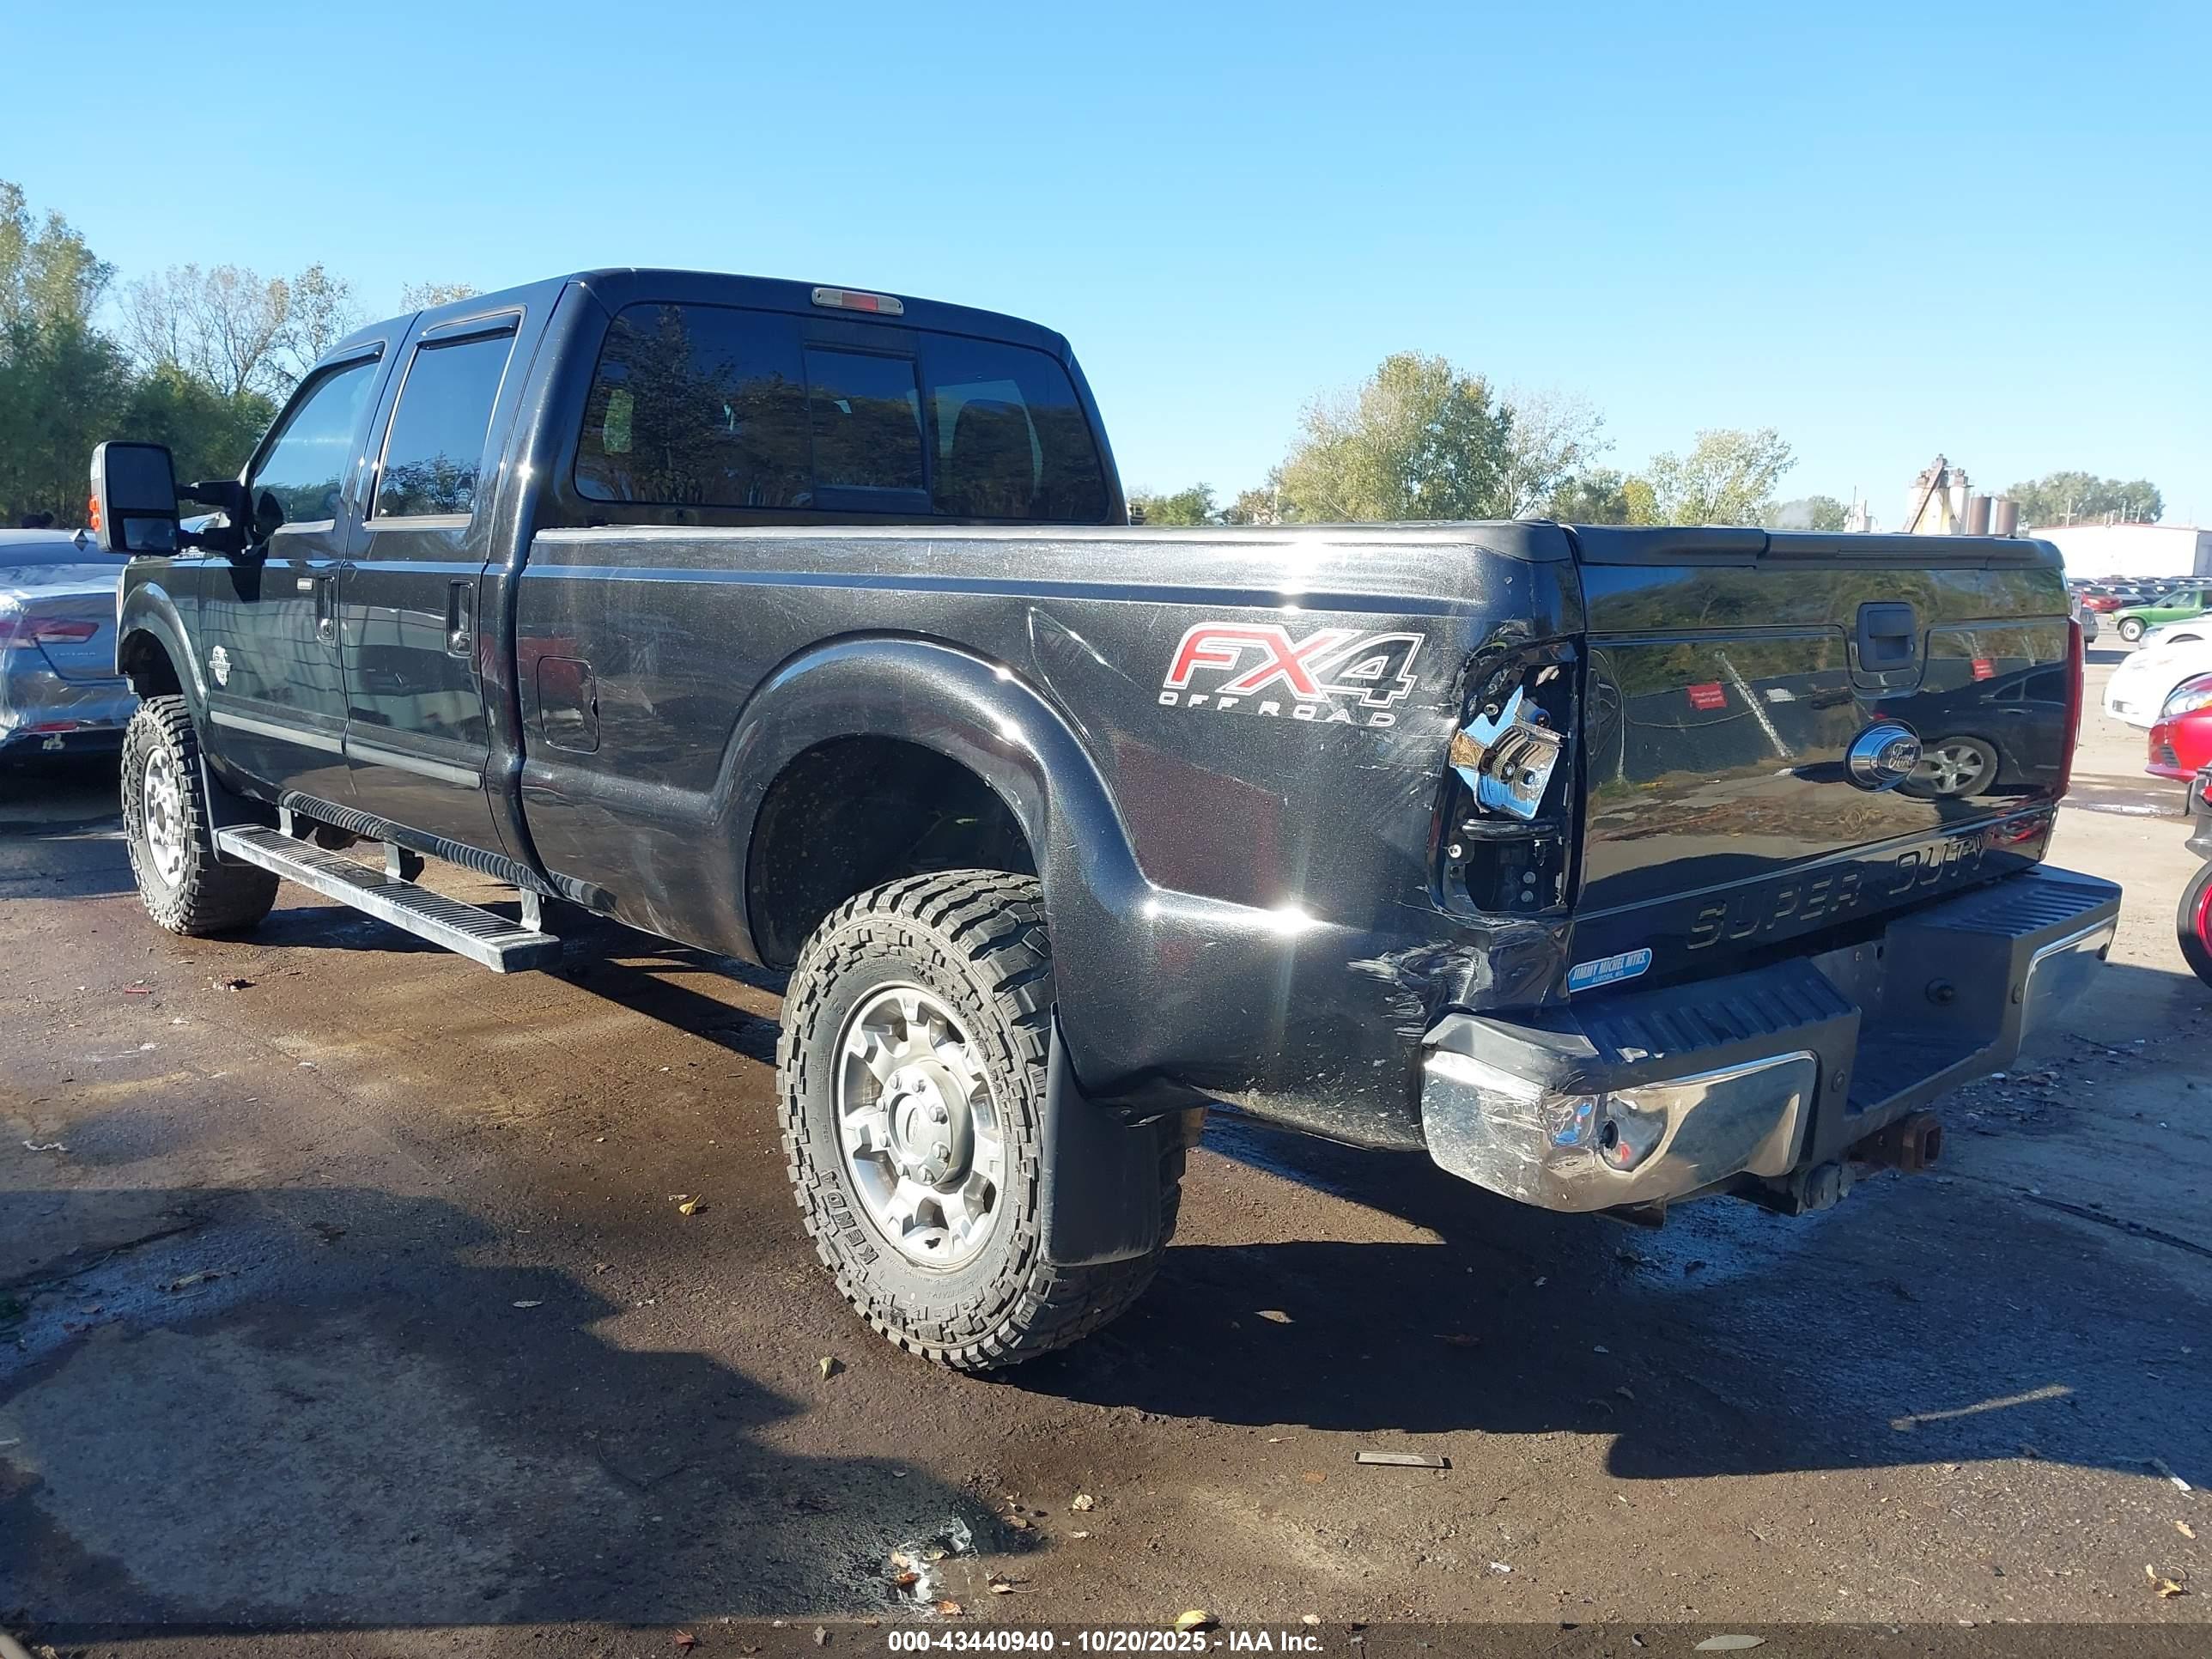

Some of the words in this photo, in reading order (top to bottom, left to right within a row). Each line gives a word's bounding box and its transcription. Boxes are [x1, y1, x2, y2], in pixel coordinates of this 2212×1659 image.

[1163, 621, 1425, 708] FX4
[1158, 690, 1240, 711] OFF
[1258, 702, 1397, 728] ROAD
[1888, 743, 1916, 769] Ford
[1686, 872, 1863, 950] SUPER
[1889, 832, 1990, 895] DUTY
[819, 1170, 879, 1265] KENDA
